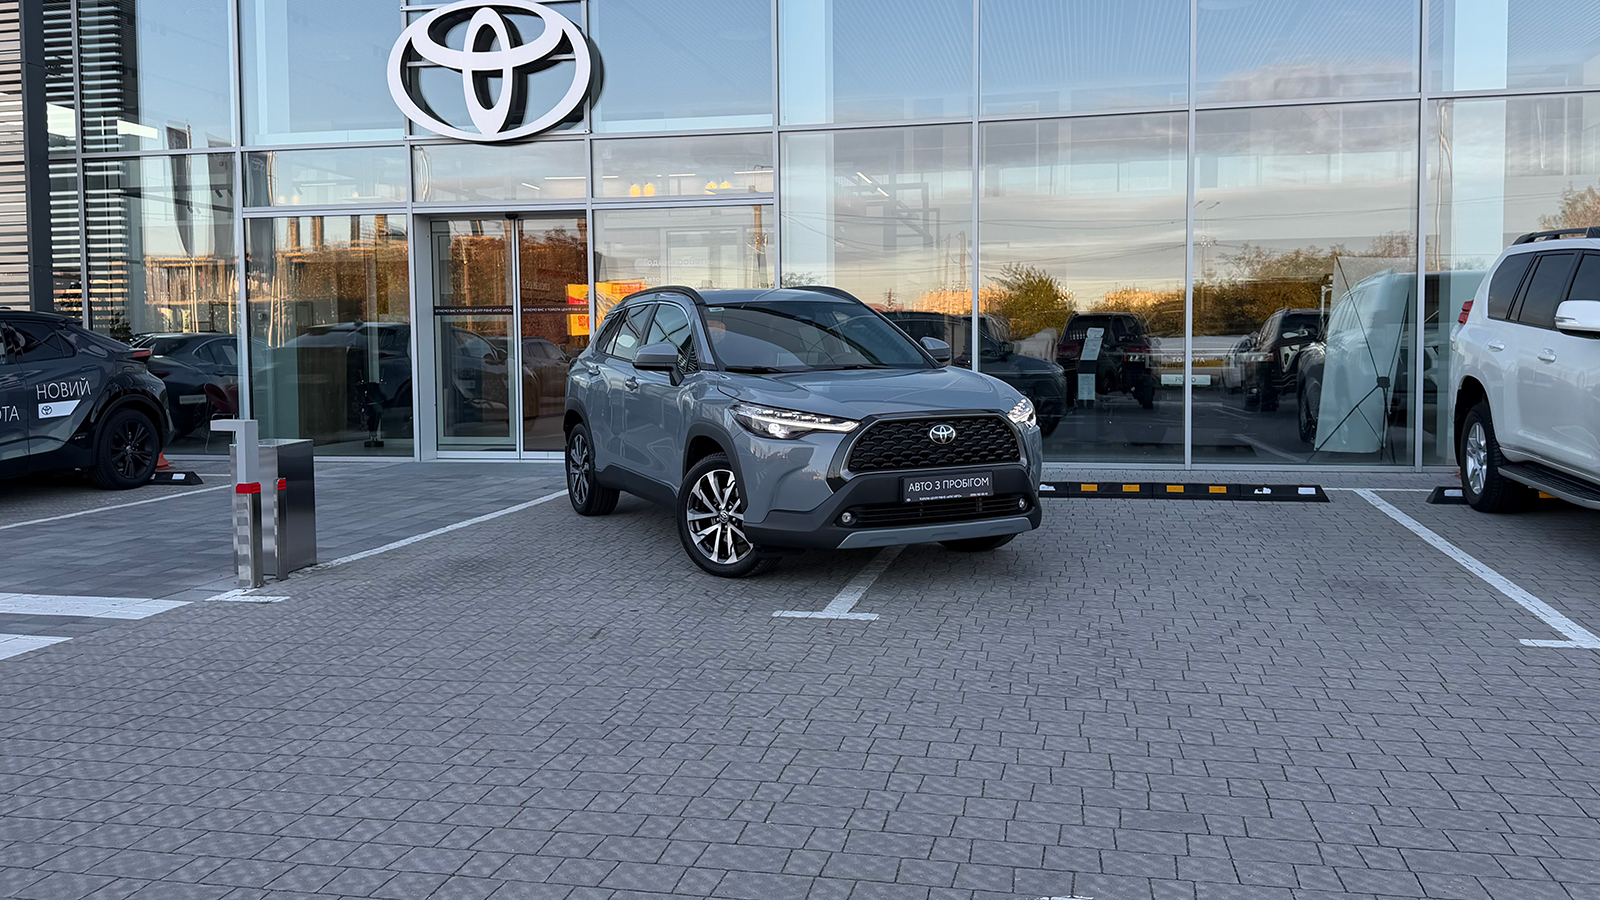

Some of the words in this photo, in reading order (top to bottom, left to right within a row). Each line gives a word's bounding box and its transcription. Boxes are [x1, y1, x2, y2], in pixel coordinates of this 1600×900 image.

[36, 377, 91, 400] НОВИЙ
[908, 481, 933, 492] АВТО
[934, 480, 941, 490] З
[942, 477, 989, 489] ПРОБІГОМ
